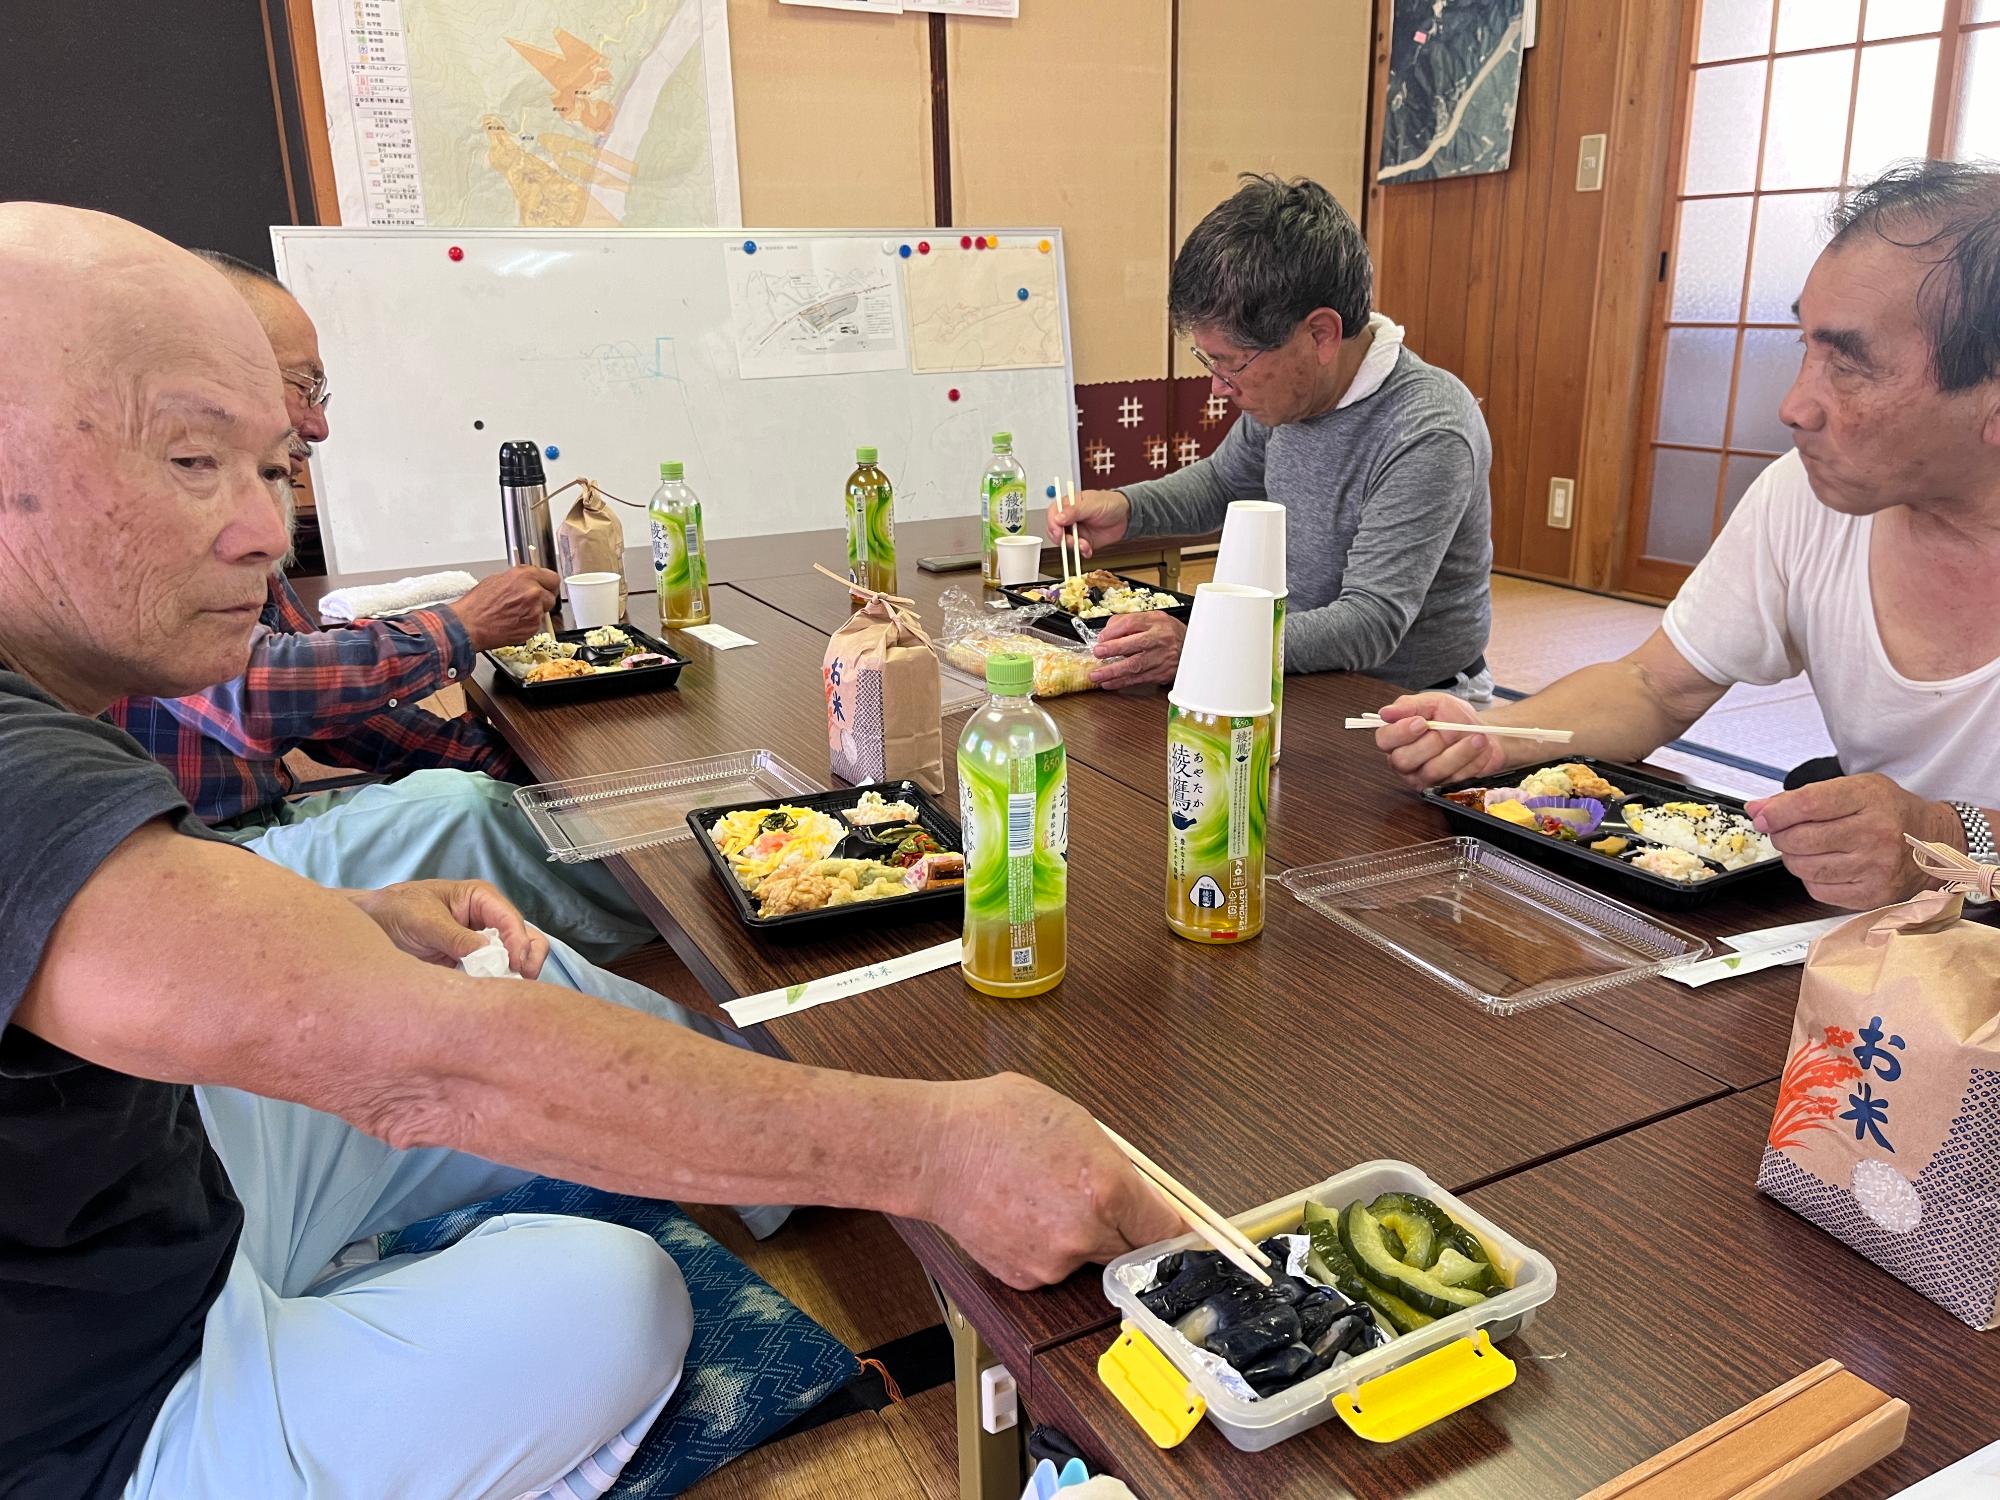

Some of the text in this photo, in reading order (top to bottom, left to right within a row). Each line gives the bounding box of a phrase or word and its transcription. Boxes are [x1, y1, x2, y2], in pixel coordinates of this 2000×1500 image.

[830, 656, 845, 722] お米
[1043, 755, 1060, 772] 650
[1172, 742, 1192, 812] 綾鷹
[1193, 752, 1204, 808] あやたか
[1840, 1016, 1906, 1154] お米
